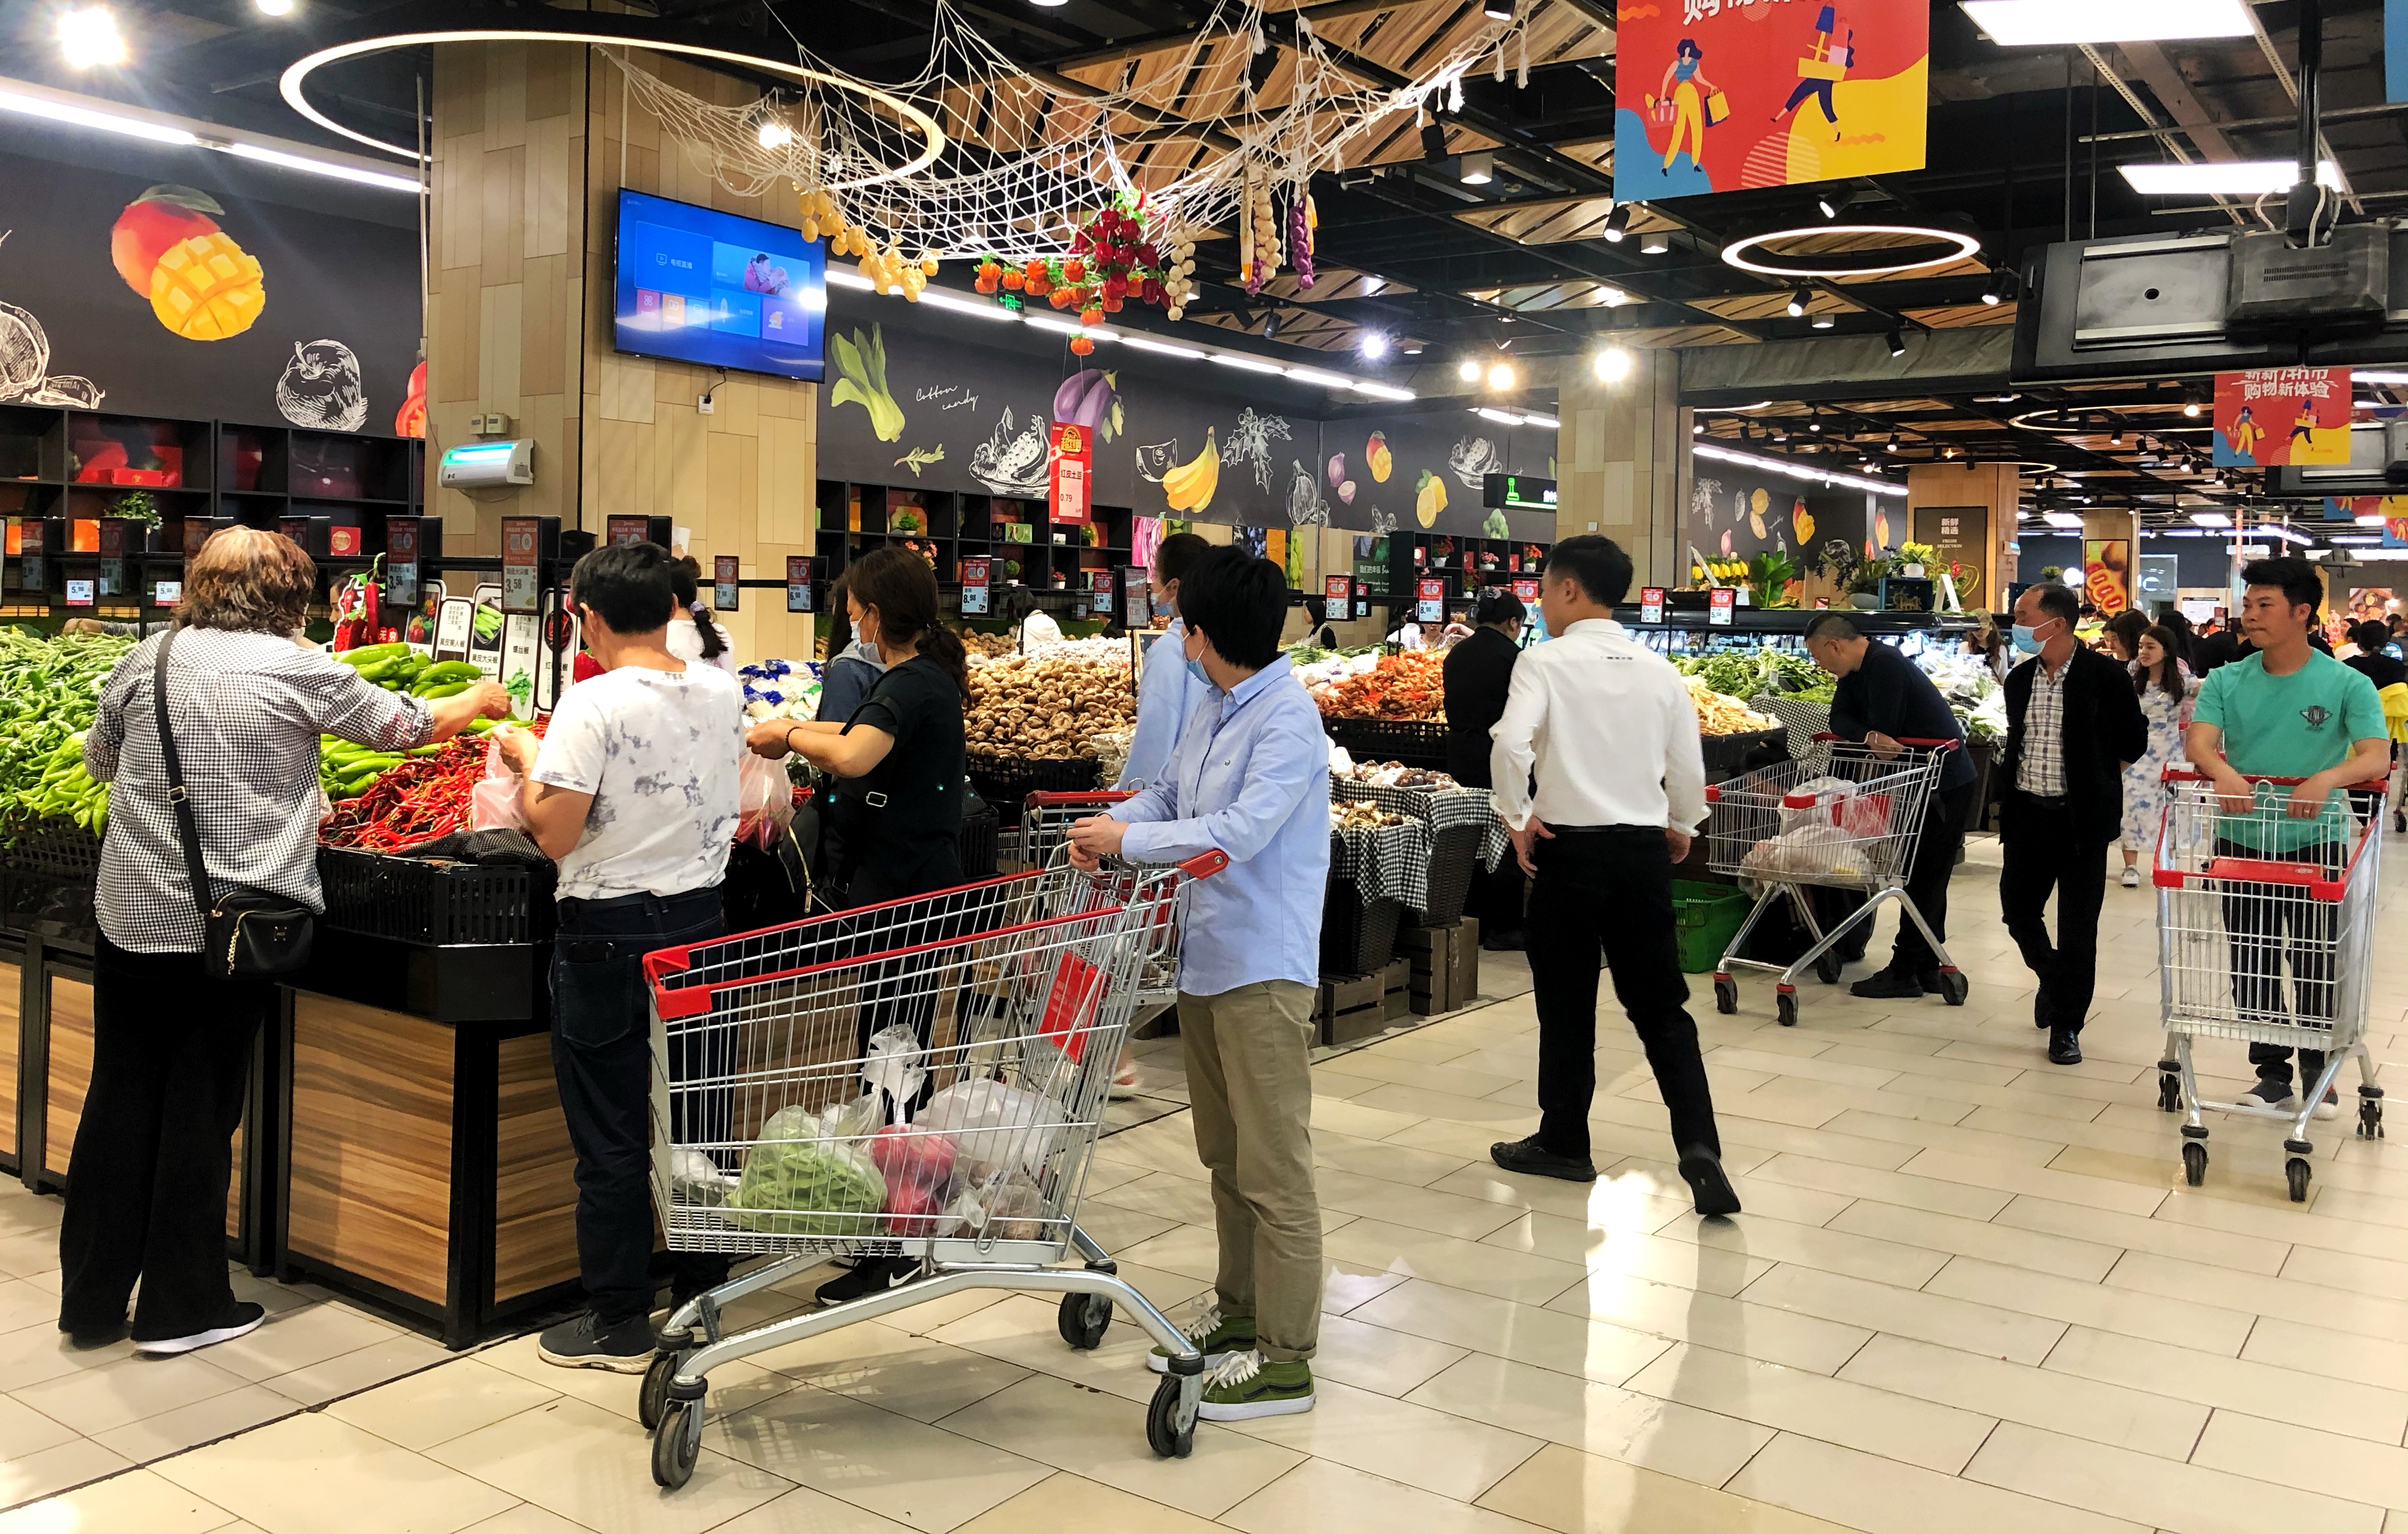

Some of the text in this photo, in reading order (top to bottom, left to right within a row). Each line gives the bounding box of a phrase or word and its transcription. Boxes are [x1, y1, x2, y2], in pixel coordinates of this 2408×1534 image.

[2244, 381, 2330, 401] 购物新体验
[1060, 469, 1082, 480] 红皮土豆
[1060, 493, 1073, 502] 0.79
[1941, 518, 1959, 526] 新鲜
[1941, 526, 1959, 535] 精选
[512, 645, 530, 654] 螺丝椒
[471, 653, 499, 664] 黄皮大尖椒
